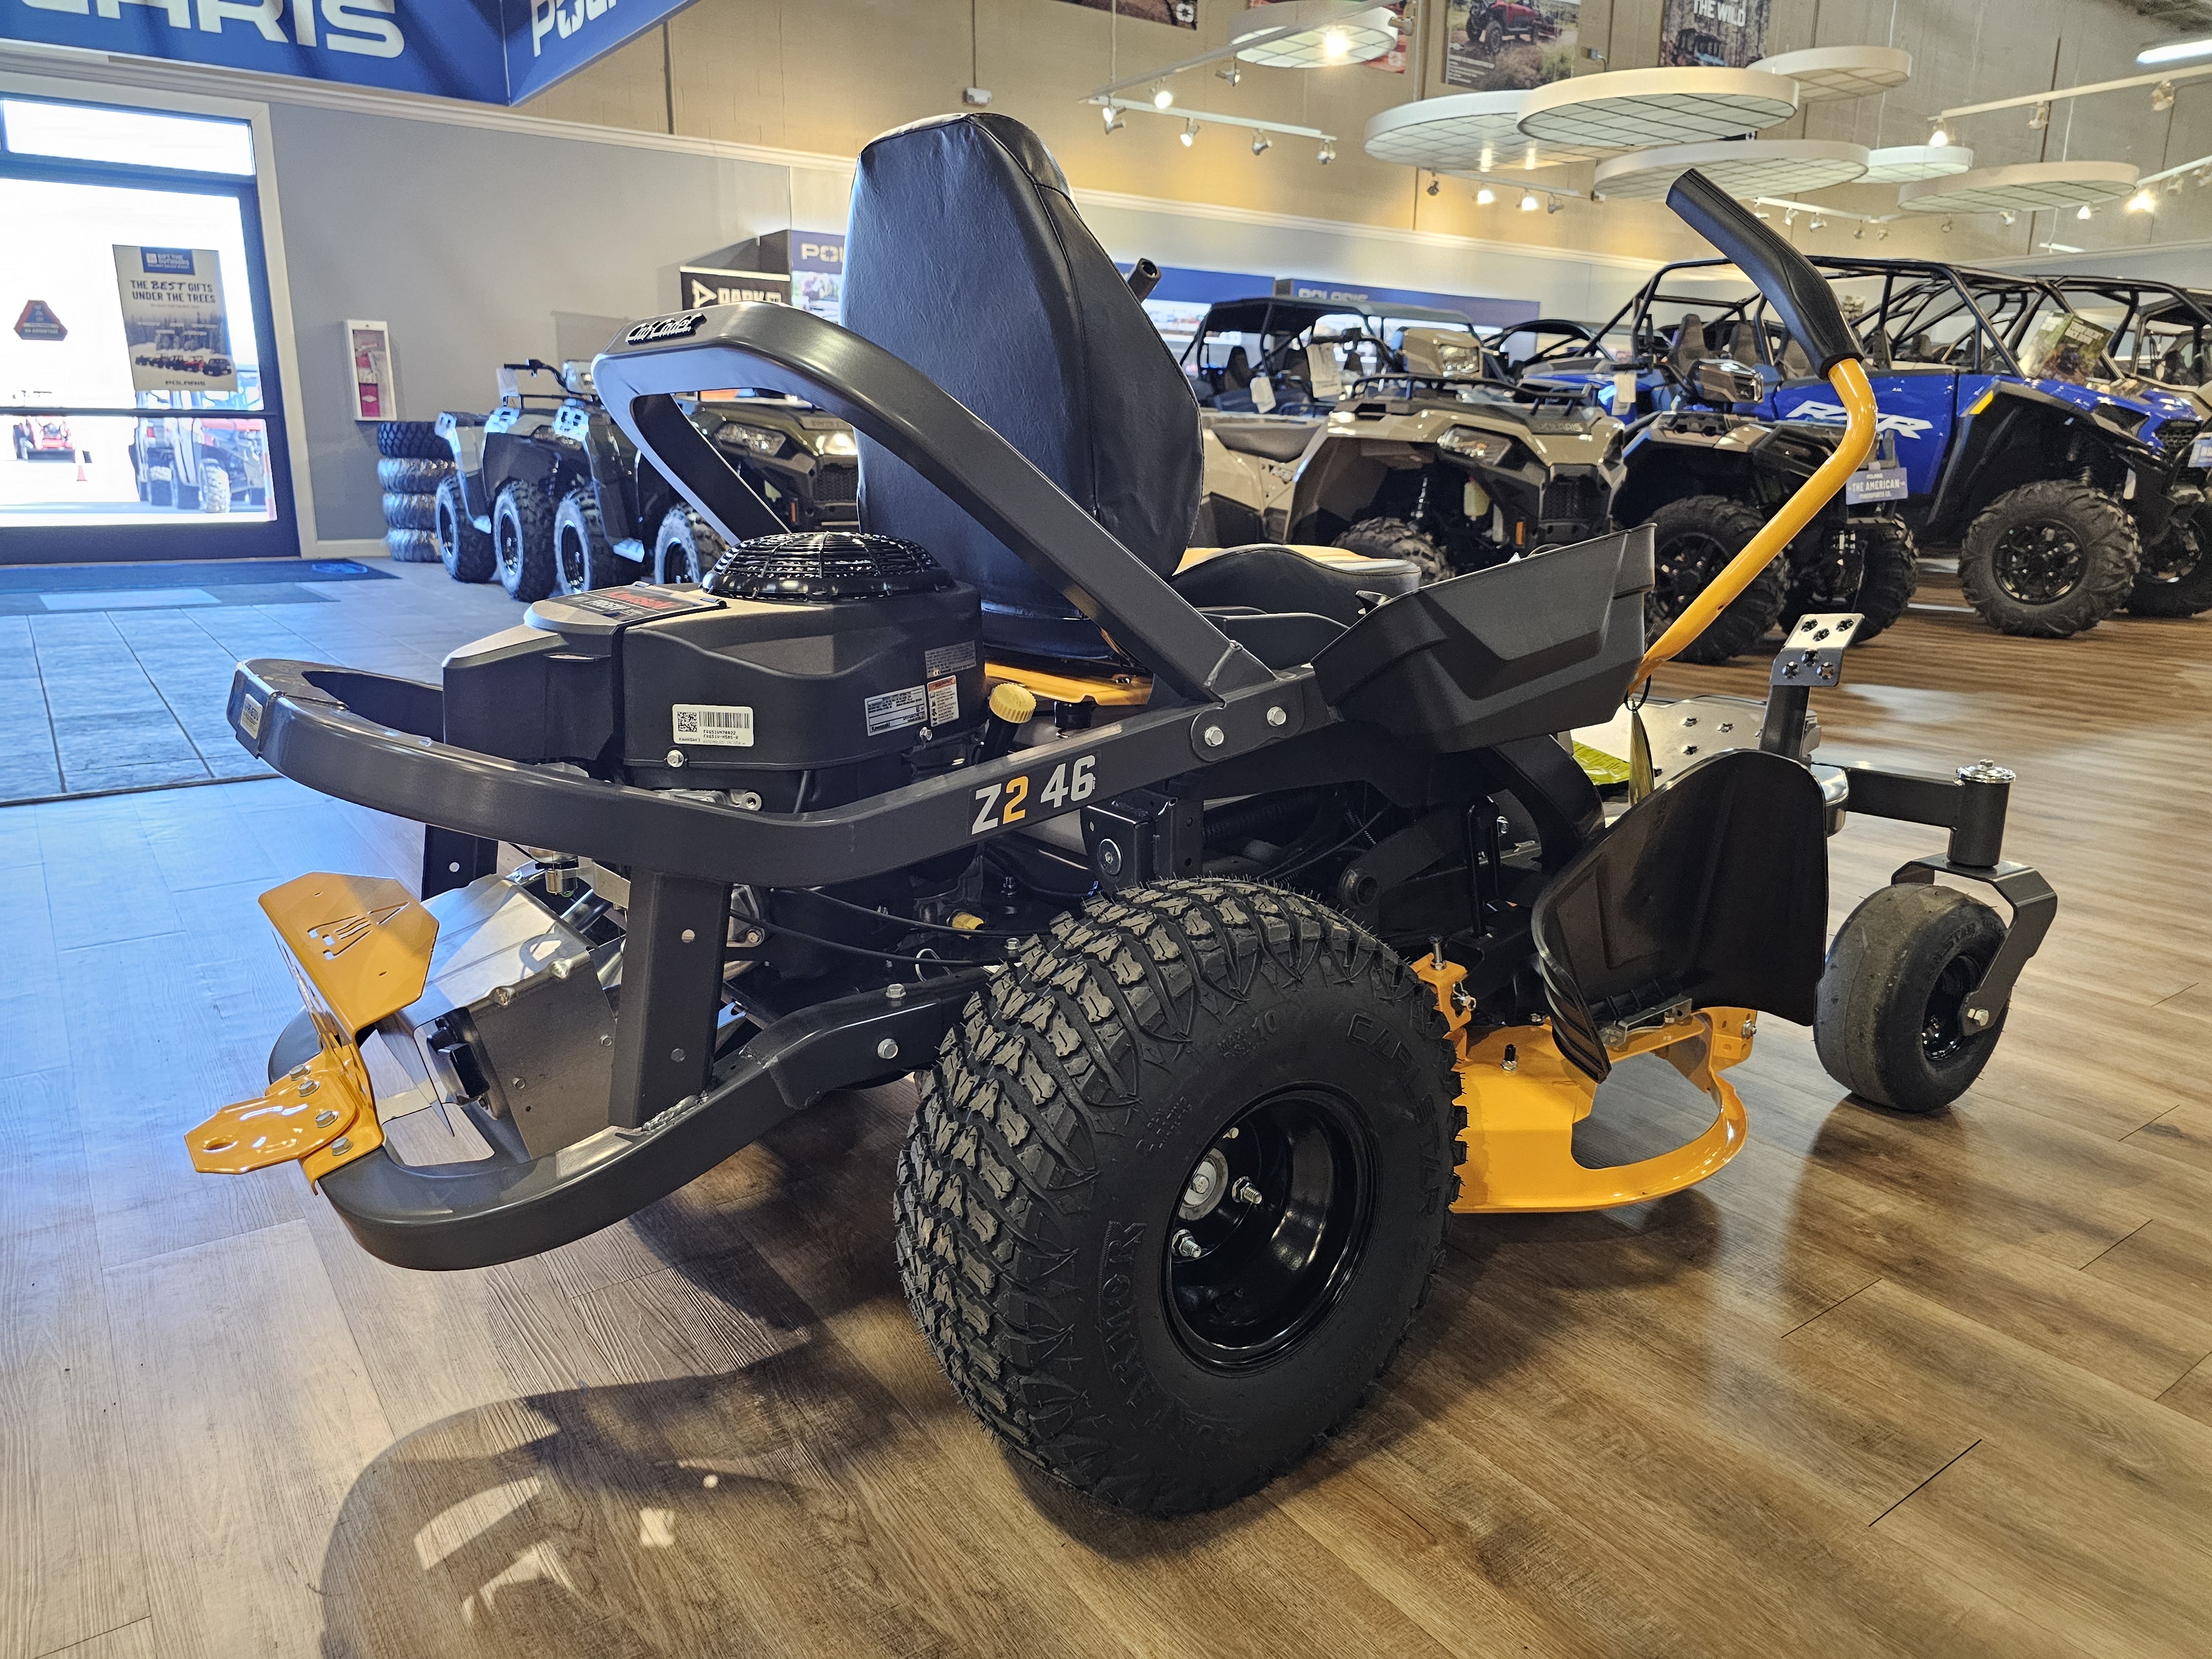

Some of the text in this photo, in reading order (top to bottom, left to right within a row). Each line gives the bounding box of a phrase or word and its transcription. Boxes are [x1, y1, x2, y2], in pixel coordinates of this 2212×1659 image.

[1693, 0, 1715, 19] THE
[1717, 2, 1746, 27] WILD
[531, 0, 617, 58] POL
[131, 279, 213, 293] THE BEST GIFTS
[132, 291, 216, 304] UNDER THE TREES
[1852, 478, 1900, 493] THE AMERICAN
[971, 755, 1096, 835] Z2 46
